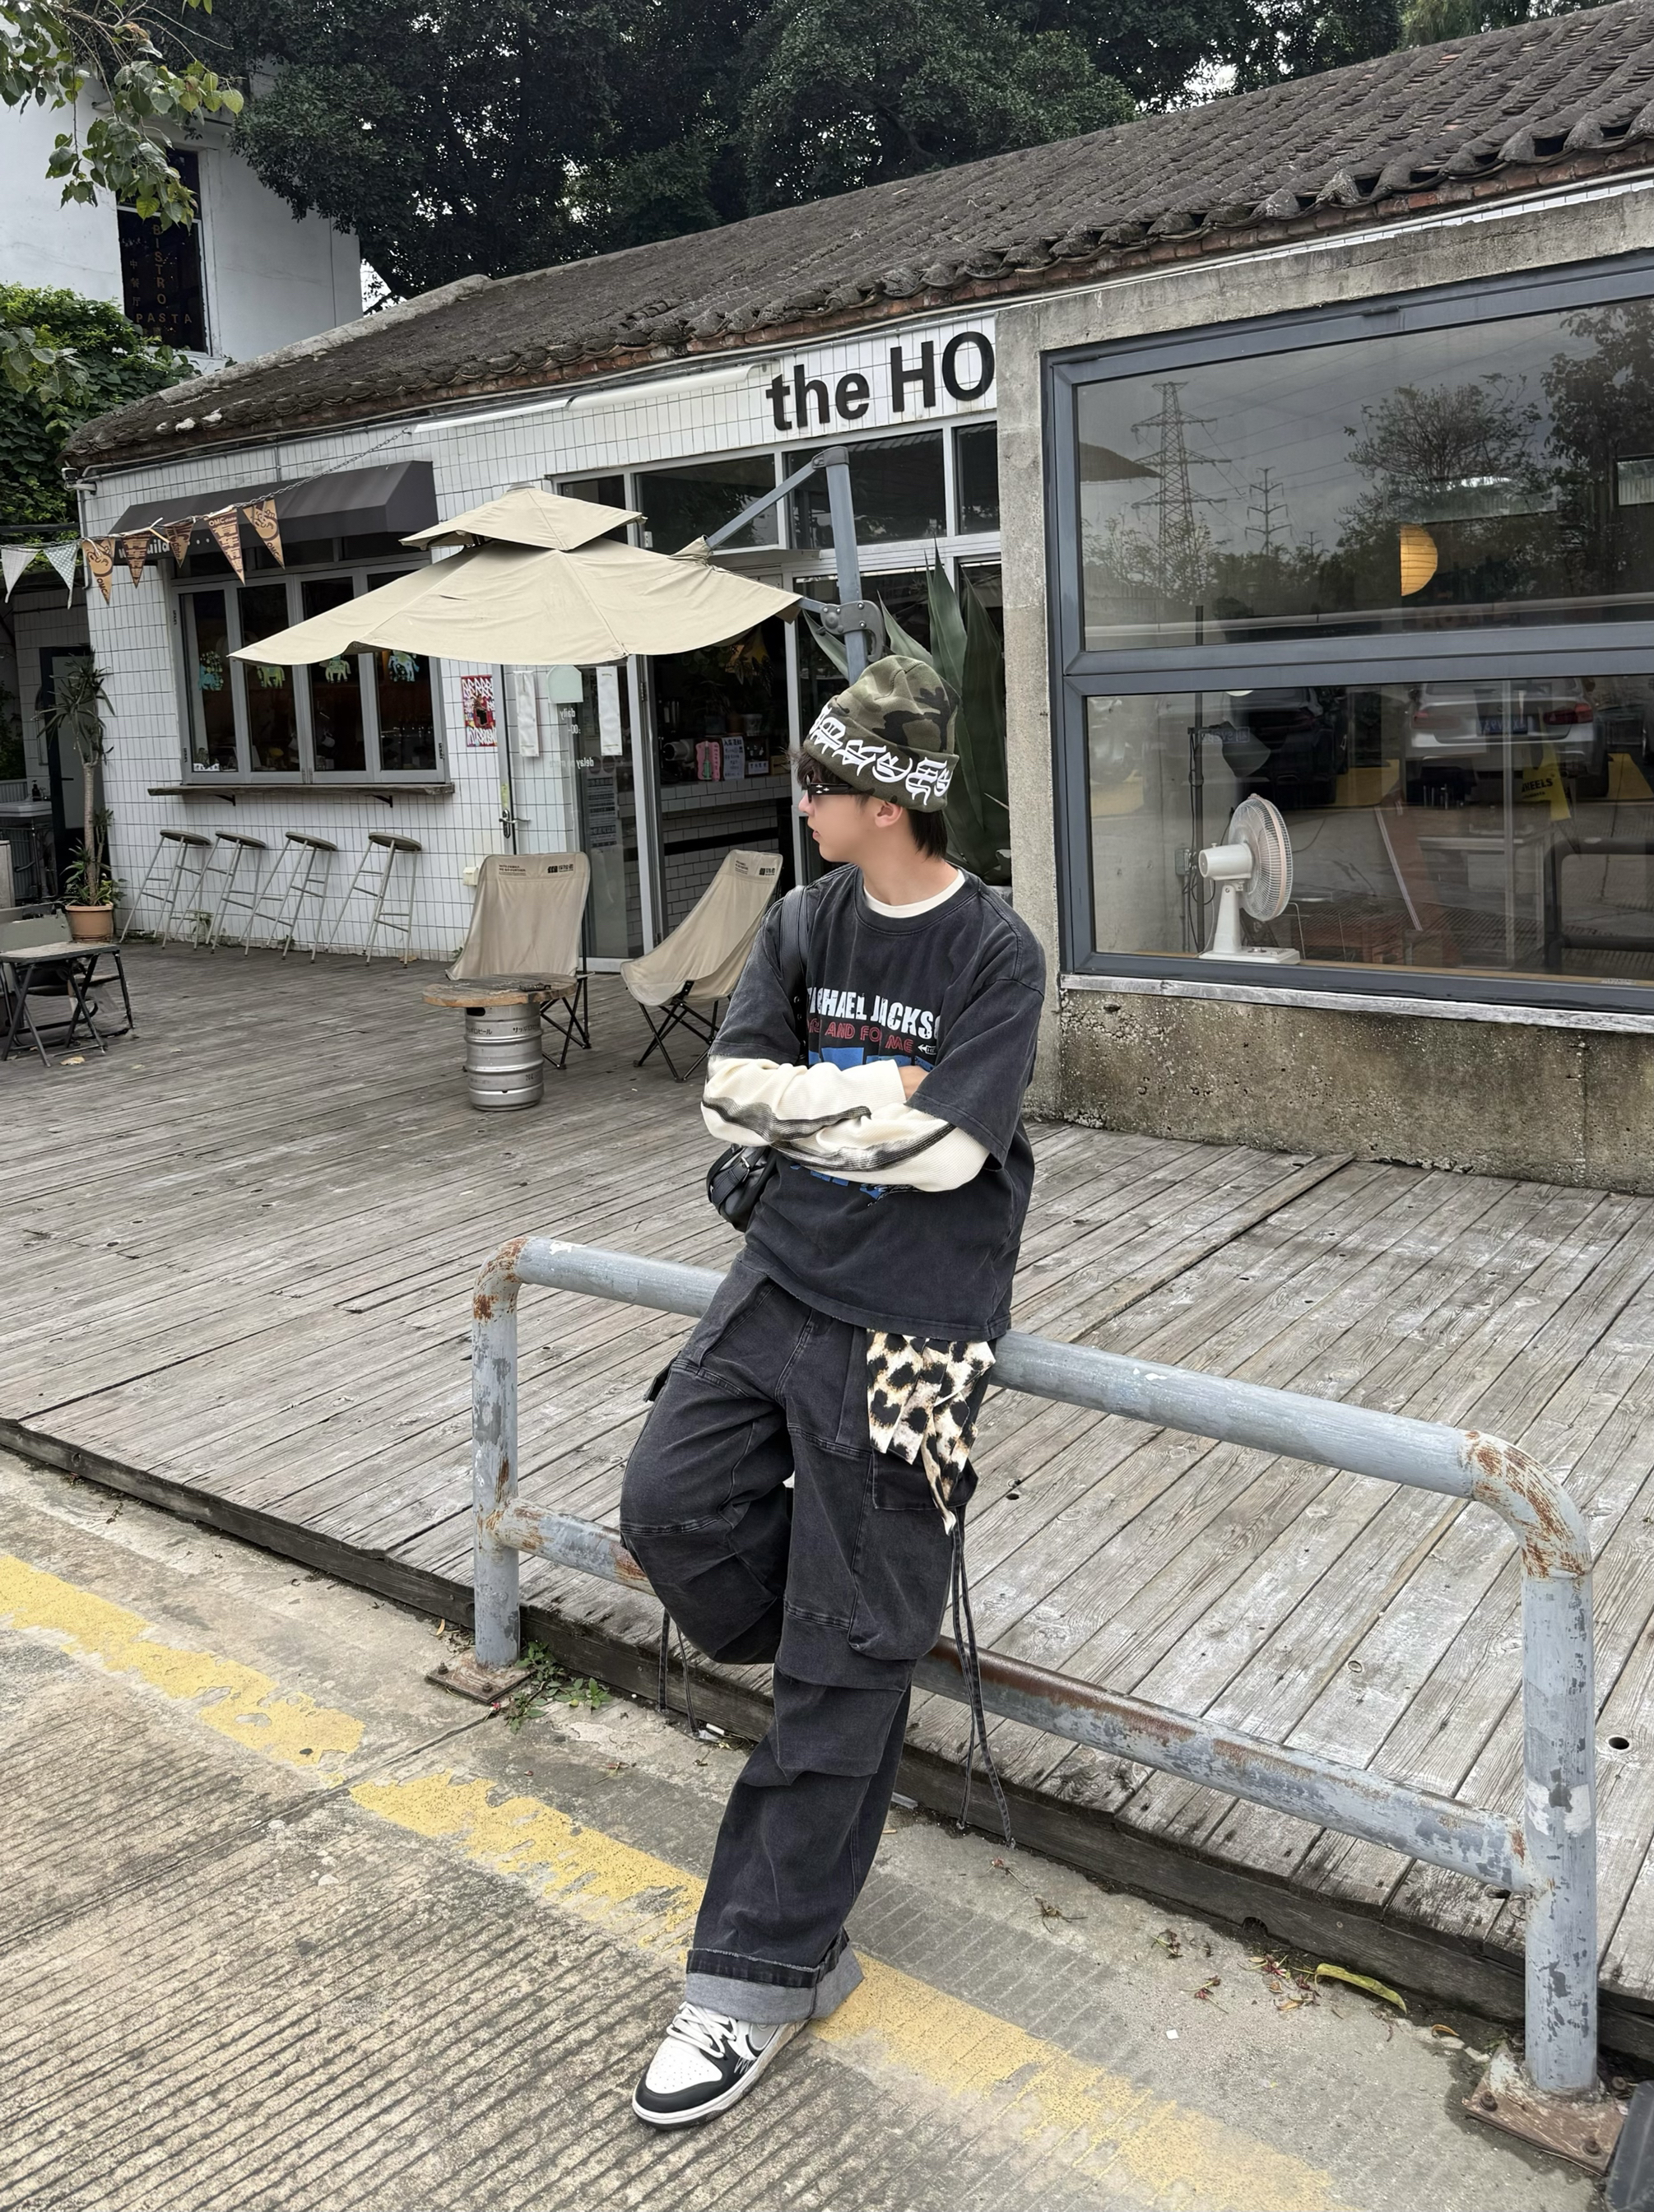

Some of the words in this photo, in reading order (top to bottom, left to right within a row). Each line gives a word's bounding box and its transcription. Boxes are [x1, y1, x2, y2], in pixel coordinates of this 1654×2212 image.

[152, 224, 167, 304] BISTRO
[136, 313, 193, 324] PASTA
[765, 365, 870, 431] the
[890, 331, 996, 413] HO
[825, 1021, 856, 1039] AND
[860, 1025, 882, 1043] FO
[885, 1034, 914, 1054] ME
